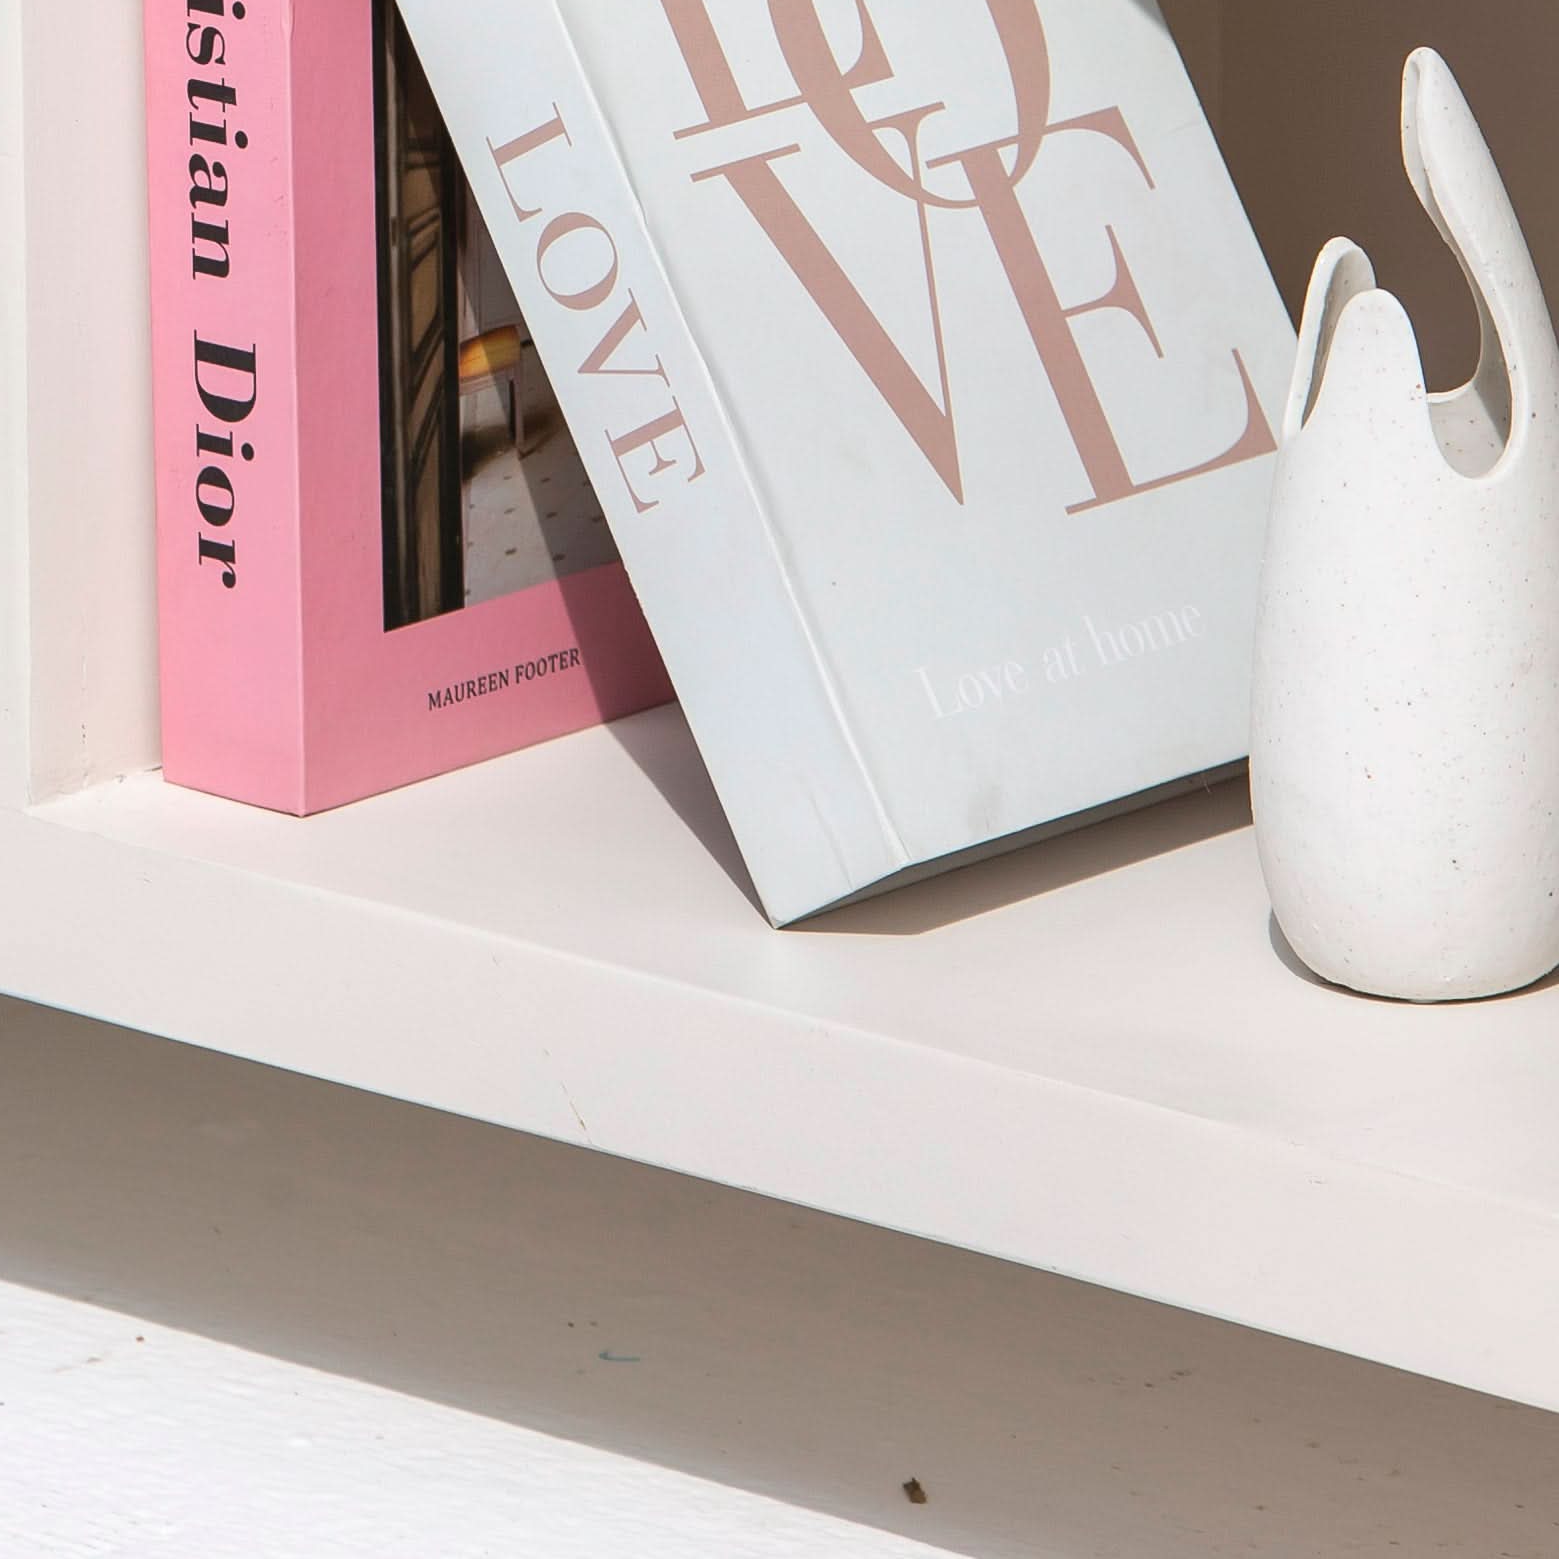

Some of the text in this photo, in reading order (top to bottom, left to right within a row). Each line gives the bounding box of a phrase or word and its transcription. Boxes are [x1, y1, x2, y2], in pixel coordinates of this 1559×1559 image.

[486, 101, 706, 515] LOVE
[193, 329, 257, 590] Dior
[427, 648, 582, 711] MAUREEN FOOTER
[911, 604, 1202, 720] Love at home
